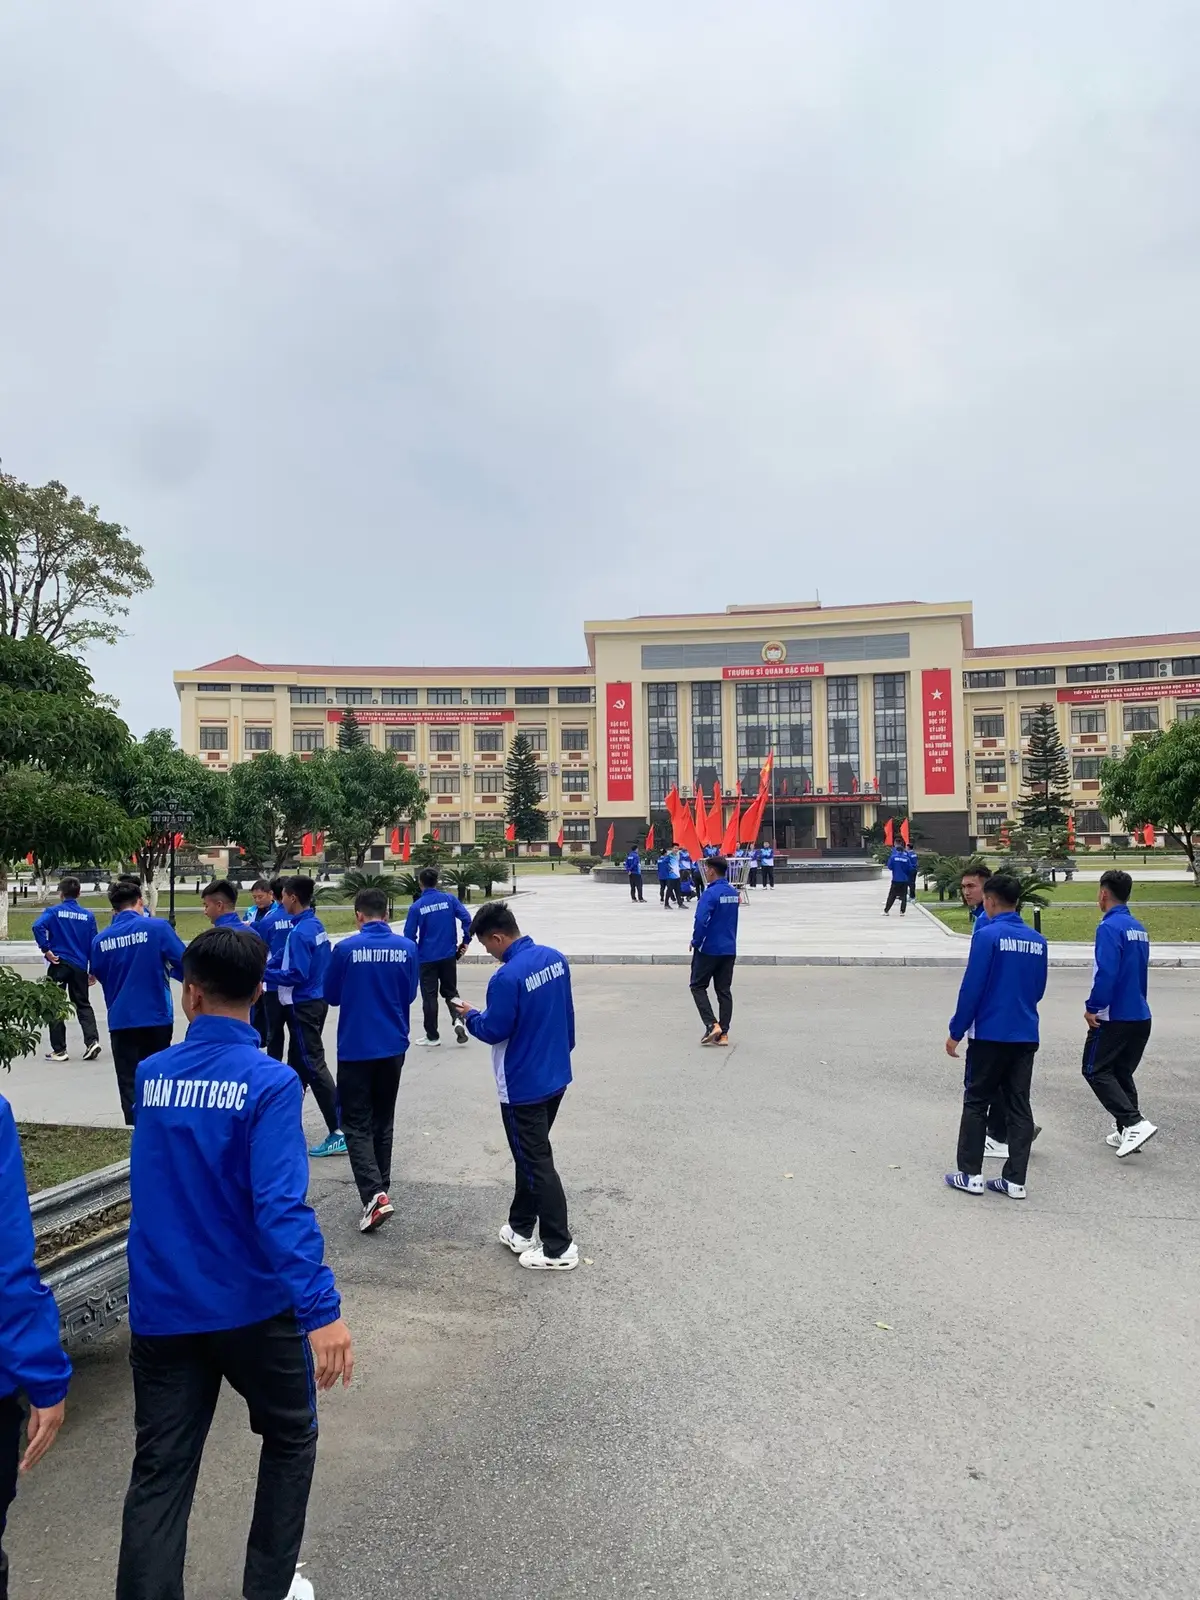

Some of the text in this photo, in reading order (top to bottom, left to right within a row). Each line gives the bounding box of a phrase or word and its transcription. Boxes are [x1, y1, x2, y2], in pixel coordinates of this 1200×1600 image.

[728, 668, 754, 677] TRƯỜNG
[764, 666, 784, 675] QUAN
[786, 666, 798, 674] ĐẶC
[800, 664, 820, 673] CÔNG
[100, 936, 116, 952] ĐOÀN
[116, 934, 131, 948] TDTT
[1000, 936, 1017, 952] ĐOÀN
[352, 946, 372, 963] ĐOÀN
[372, 948, 389, 962] TDTT
[525, 972, 542, 992] ĐOÀN
[174, 1080, 209, 1108] TDTT
[207, 1080, 248, 1111] BCĐC
